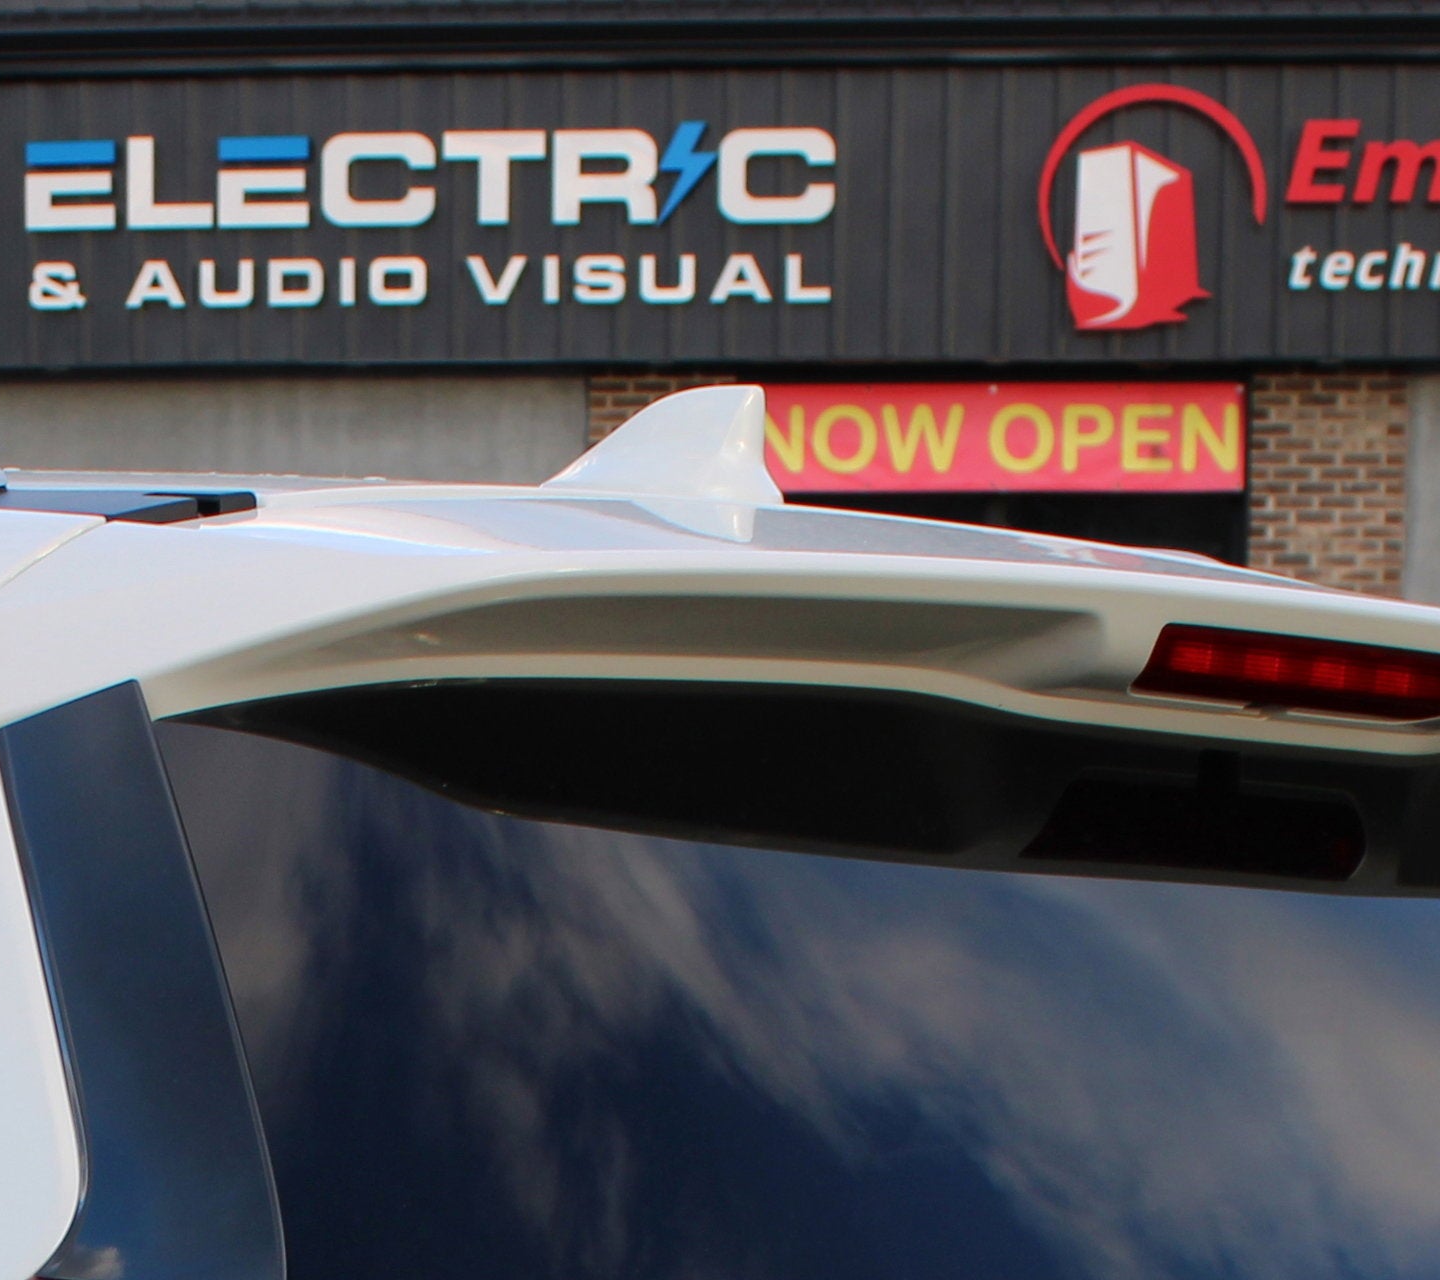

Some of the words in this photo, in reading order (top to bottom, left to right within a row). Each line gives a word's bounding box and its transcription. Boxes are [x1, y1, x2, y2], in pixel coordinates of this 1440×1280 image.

[28, 261, 87, 311] &
[124, 255, 429, 309] AUDIO
[465, 253, 833, 305] VISUAL
[763, 404, 965, 475] NOW
[987, 403, 1239, 474] OPEN
